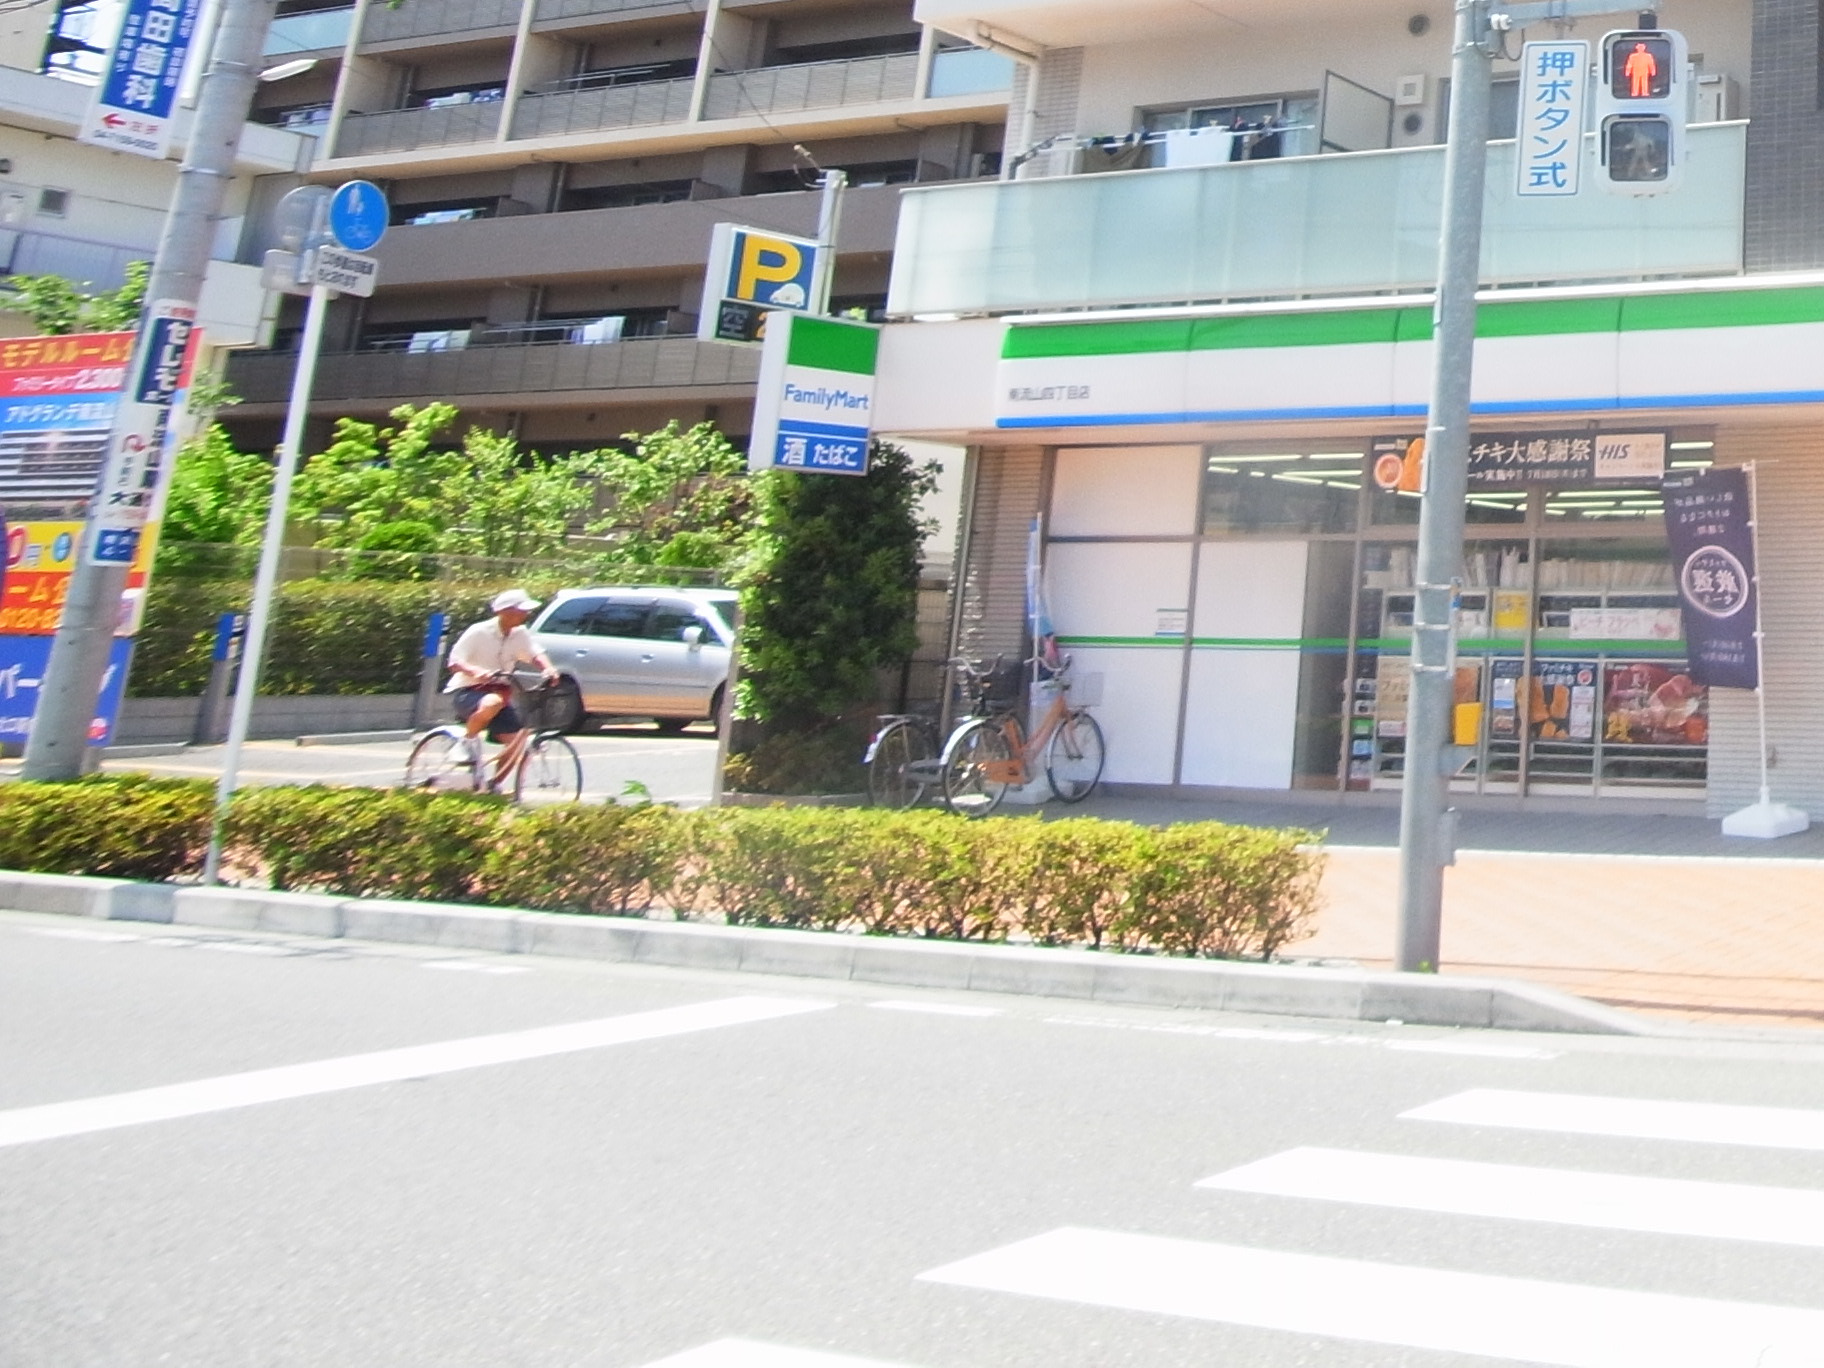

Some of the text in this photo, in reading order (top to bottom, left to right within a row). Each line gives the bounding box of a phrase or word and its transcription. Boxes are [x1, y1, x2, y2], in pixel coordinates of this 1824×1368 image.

[1529, 51, 1575, 188] 押ボタン式
[737, 233, 801, 300] P
[784, 384, 869, 411] FamilyMart
[782, 438, 858, 466] 酒 たばこ
[1599, 444, 1631, 460] HIS
